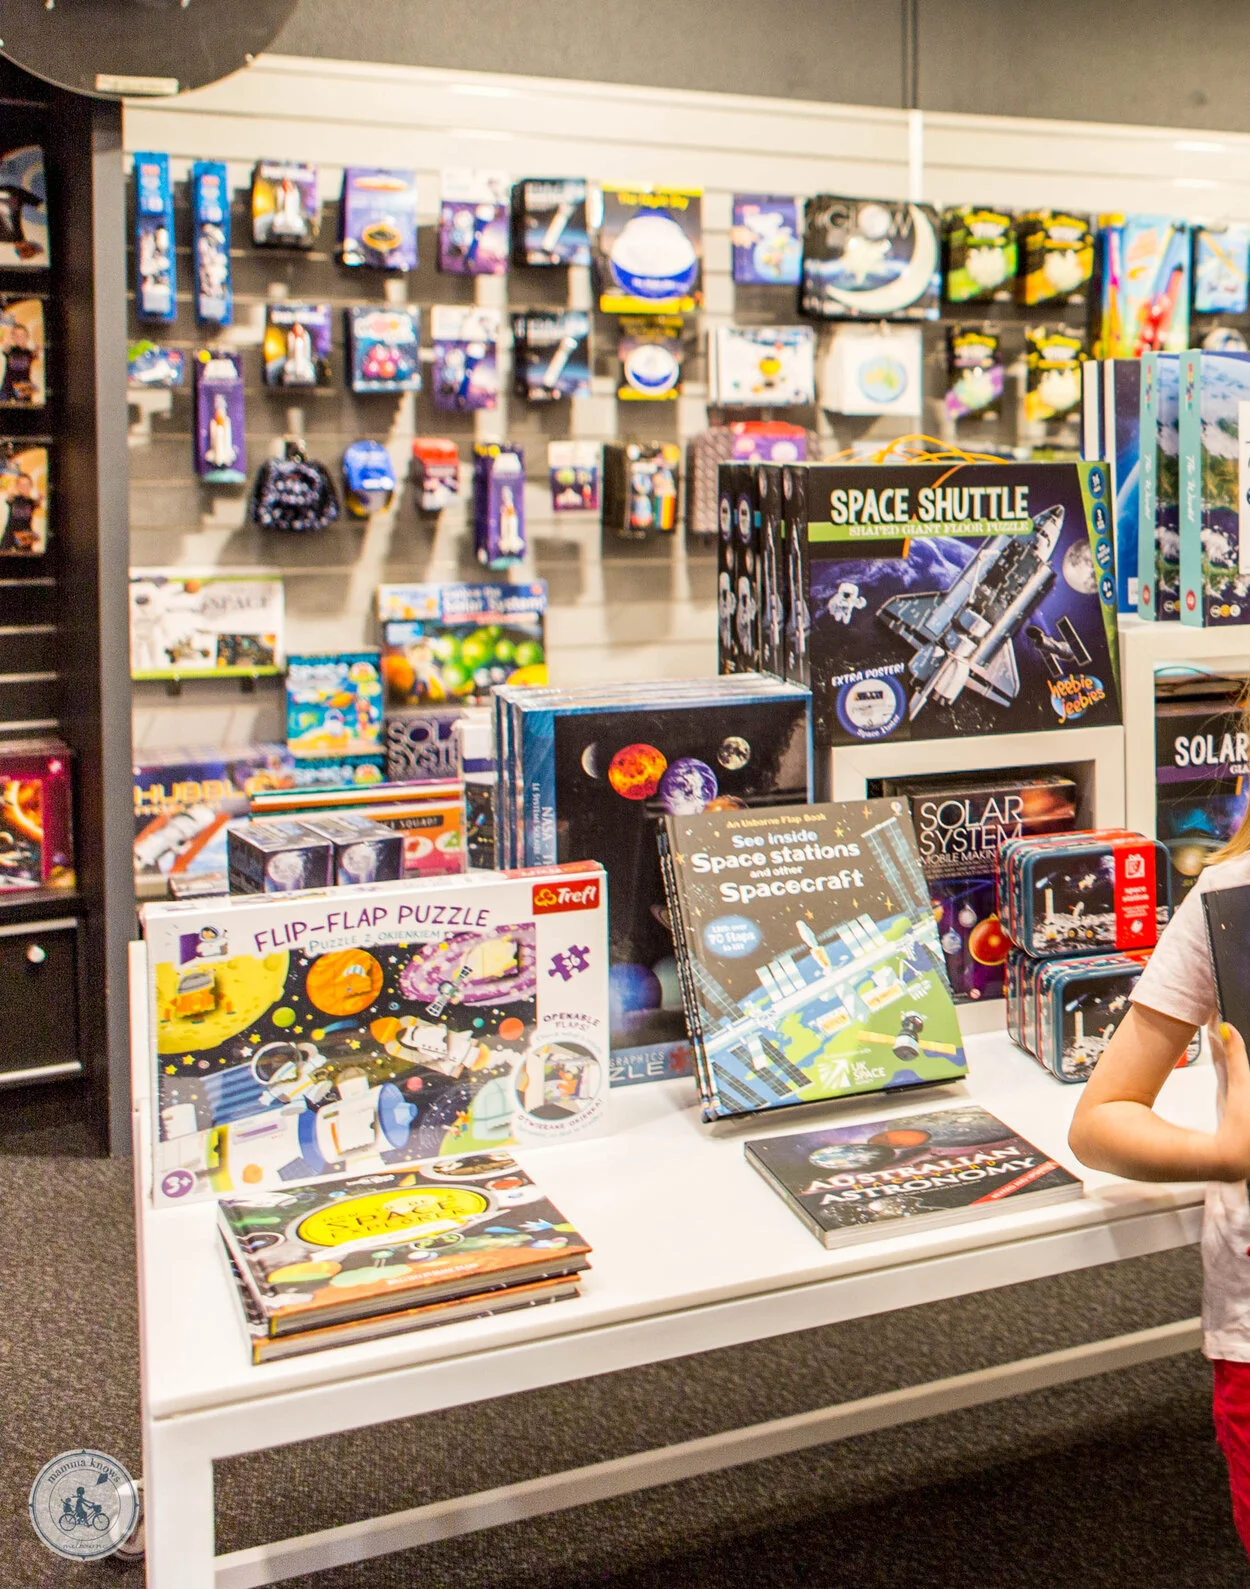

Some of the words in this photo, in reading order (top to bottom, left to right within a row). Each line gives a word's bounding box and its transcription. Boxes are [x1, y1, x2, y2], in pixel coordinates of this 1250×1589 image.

[830, 487, 909, 525] SPACE
[918, 486, 1029, 521] SHUTTLE
[849, 524, 900, 537] SHAPED
[902, 523, 942, 534] GIANT
[944, 521, 983, 533] FLOOR
[987, 520, 1029, 532] PUZZLE
[831, 671, 863, 687] EXTRA
[864, 662, 905, 679] POSTER!
[1046, 674, 1093, 700] heebie
[1058, 688, 1105, 724] jeebies
[1174, 732, 1249, 767] SOLAR
[541, 806, 553, 841] NASA
[726, 820, 740, 829] An
[741, 818, 779, 827] Usborne
[780, 816, 802, 825] Flap
[803, 813, 827, 822] Book
[920, 795, 1024, 831] SOLAR
[731, 834, 765, 848] See
[768, 829, 818, 845] inside
[920, 822, 1022, 855] SYSTEM
[691, 852, 767, 874] Space
[770, 843, 861, 864] stations
[920, 852, 959, 864] MOBILE
[961, 850, 997, 861] MAKIN
[749, 867, 772, 878] and
[773, 865, 804, 876] other
[557, 884, 597, 903] Trefl
[719, 868, 864, 904] Spacecraft
[1124, 886, 1147, 894] space
[254, 906, 388, 952] FLIP-FLAP
[399, 904, 491, 927] PUZZLE
[378, 929, 440, 941] OKIENKIEM
[543, 1012, 600, 1027] OPENABLE
[608, 1061, 664, 1082] ZLE
[609, 1051, 664, 1069] GRAPHICS
[851, 1061, 866, 1070] UK
[853, 1067, 886, 1080] SPACE
[803, 1146, 1021, 1193] AUSTRALIAN
[819, 1157, 1036, 1206] ASTRONOMY
[852, 1160, 997, 1191] BACKYARD
[166, 1175, 192, 1194] 3+
[327, 1197, 455, 1230] SPACE
